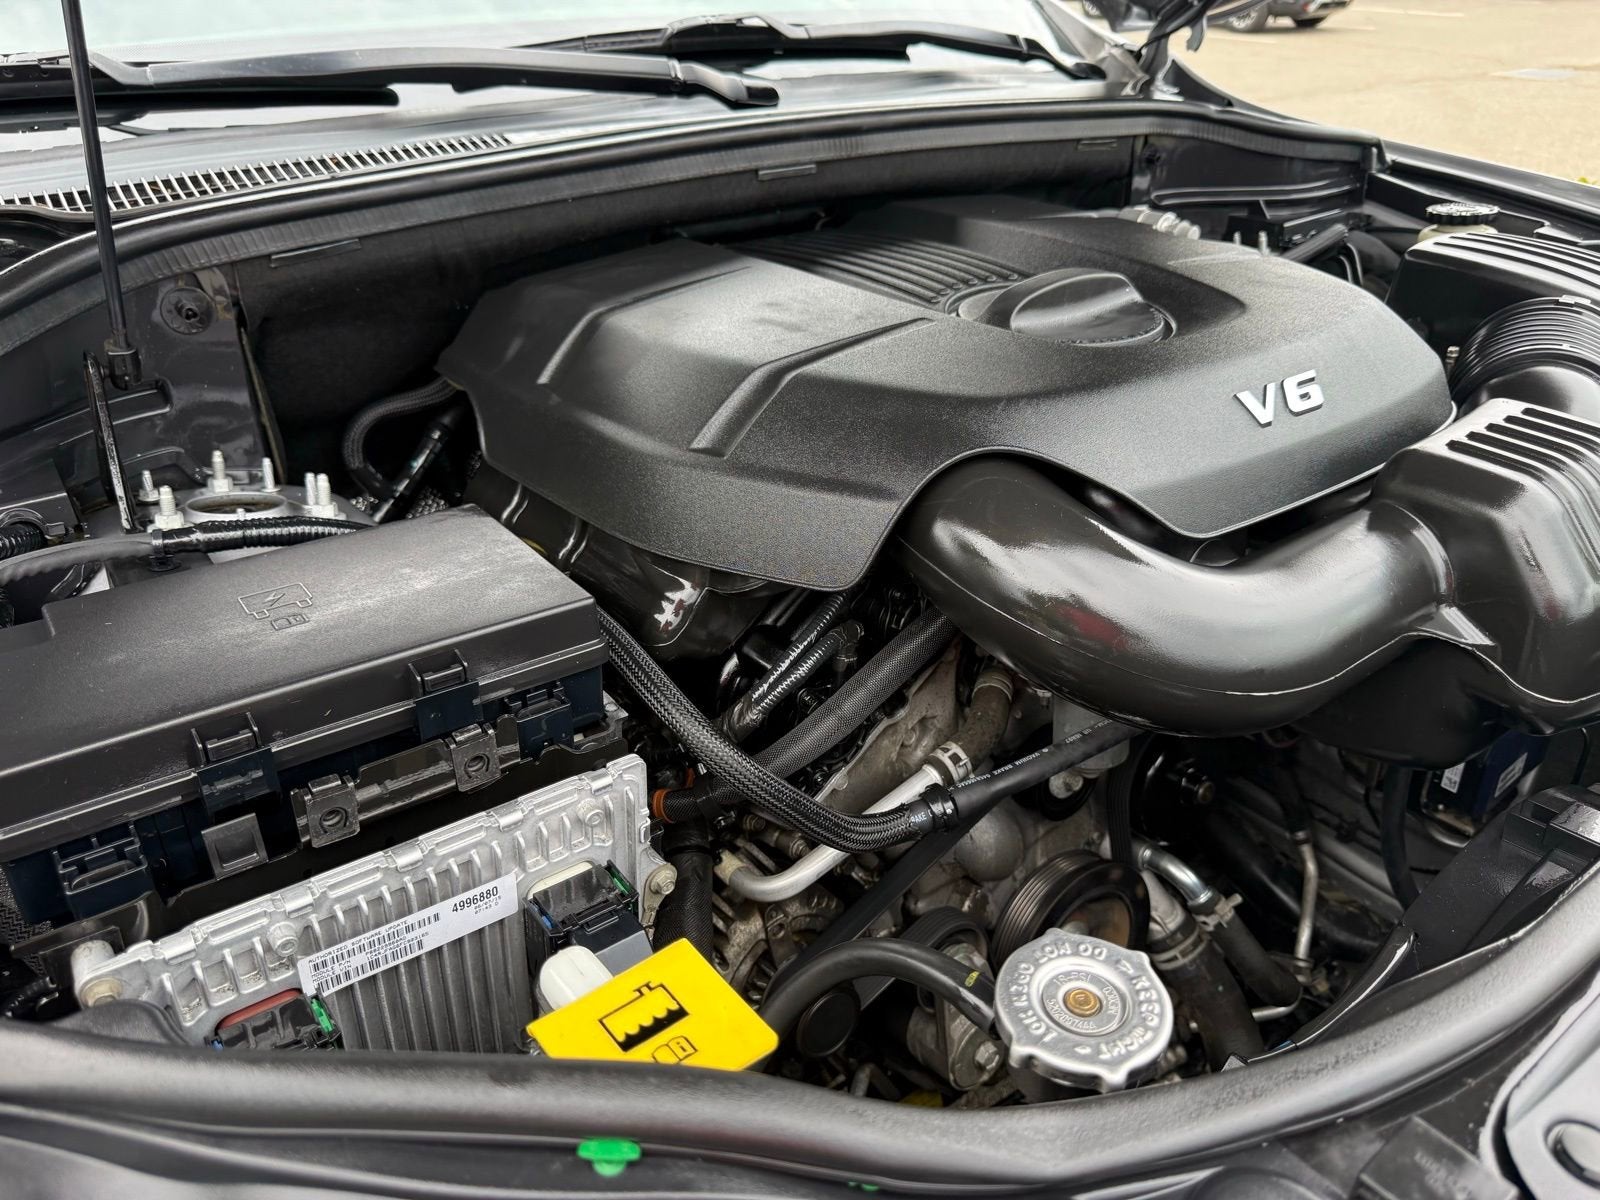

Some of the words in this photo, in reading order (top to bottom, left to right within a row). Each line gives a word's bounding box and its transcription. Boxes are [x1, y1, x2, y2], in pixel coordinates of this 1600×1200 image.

[1233, 369, 1324, 427] V6
[451, 886, 499, 914] 4996880
[308, 945, 348, 963] AUTHORIZED
[351, 931, 382, 946] SOFTWARE
[385, 920, 408, 932] UPDATE
[1078, 943, 1107, 961] DO
